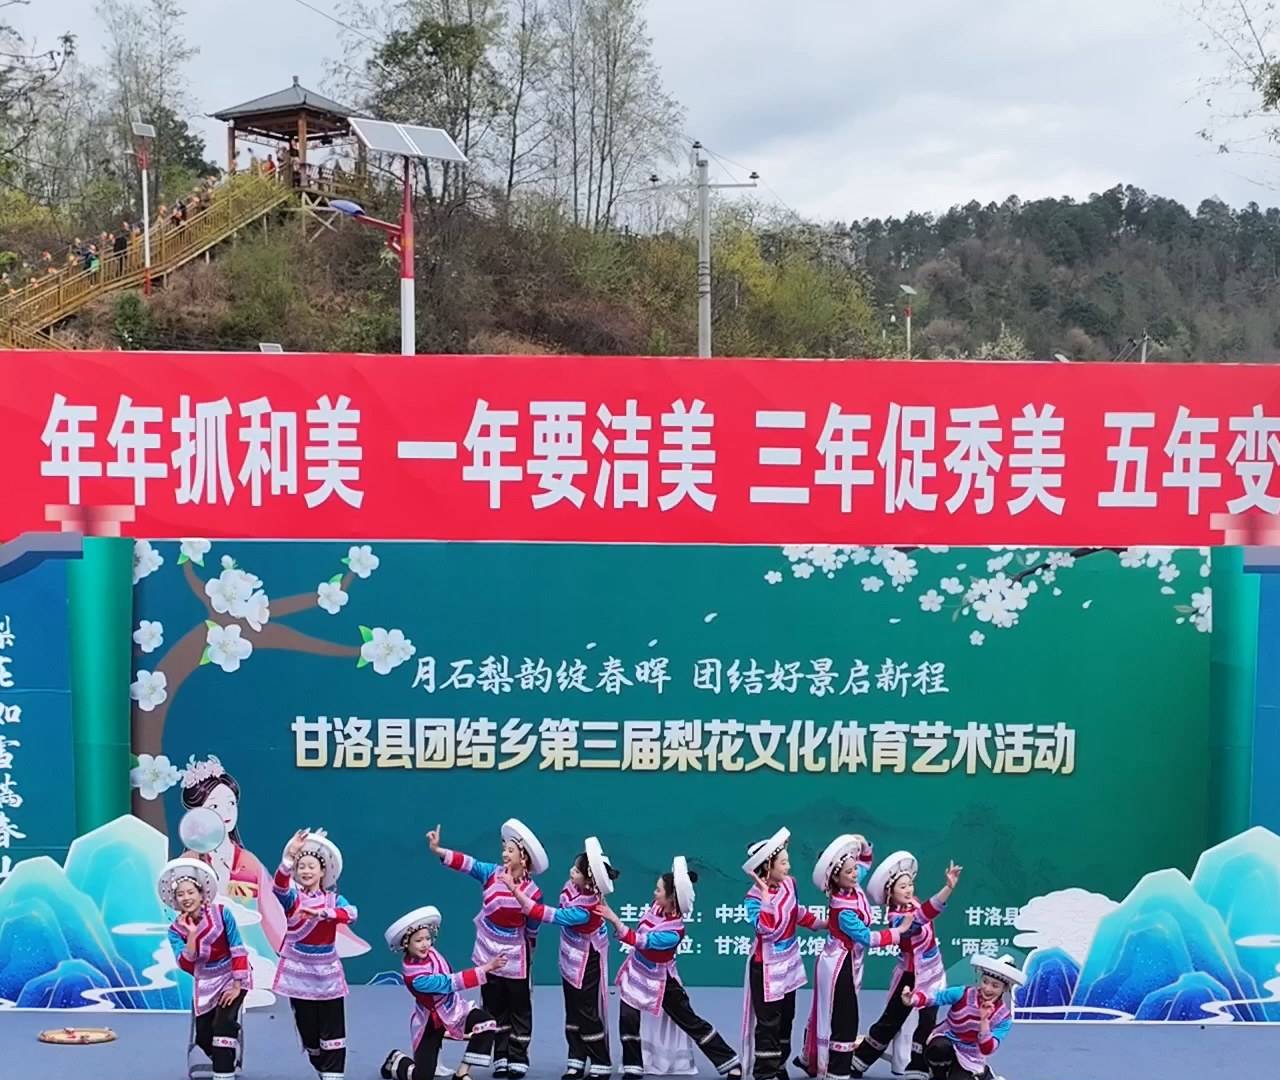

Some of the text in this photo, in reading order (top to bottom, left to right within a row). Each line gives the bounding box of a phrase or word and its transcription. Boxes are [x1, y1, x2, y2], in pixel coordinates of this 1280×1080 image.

[40, 392, 364, 509] 年年抓和美
[397, 397, 718, 513] 一年要洁美
[749, 402, 1066, 517] 三年促秀美
[411, 655, 950, 698] 月石梨韵绽春晖 团结好景启新程
[291, 715, 1077, 775] 甘洛县团结乡第三届梨花文化体育艺术活动
